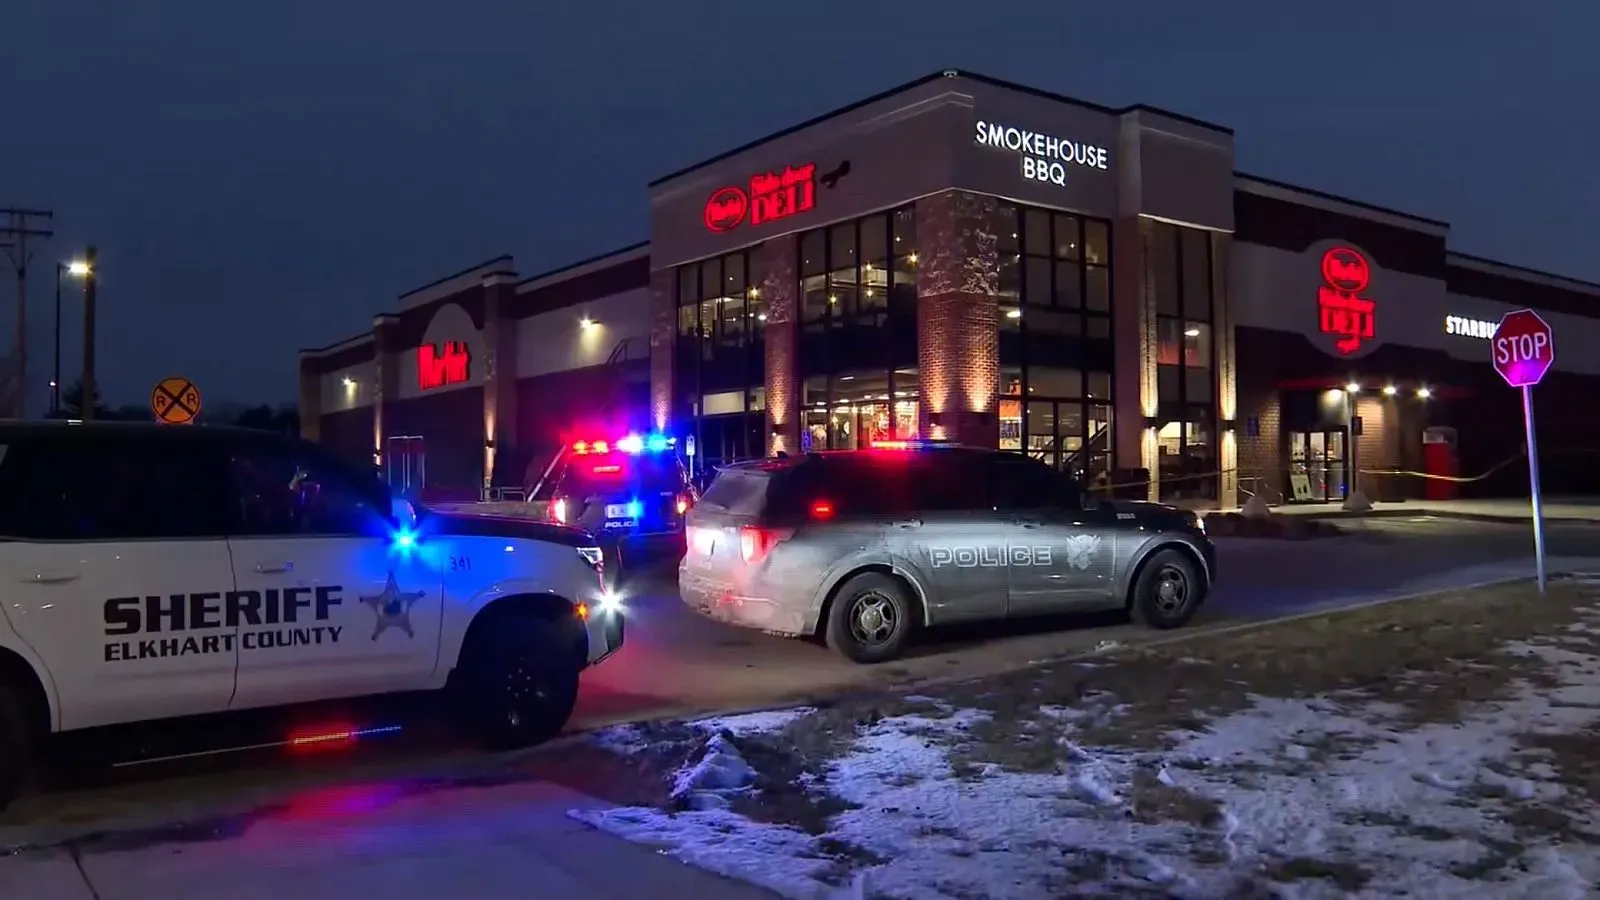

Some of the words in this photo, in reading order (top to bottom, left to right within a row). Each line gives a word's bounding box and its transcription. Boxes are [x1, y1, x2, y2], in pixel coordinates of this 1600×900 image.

[976, 120, 1108, 170] SMOKEHOUSE
[1023, 156, 1066, 187] BBQ
[1446, 315, 1500, 340] STARBU
[1497, 332, 1548, 364] STOP
[156, 394, 166, 408] R
[186, 392, 197, 406] R
[449, 556, 471, 572] 341
[929, 546, 1053, 568] POLICE
[103, 585, 343, 636] SHERIFF
[104, 633, 237, 663] ELKHART
[242, 625, 343, 650] COUNTY
